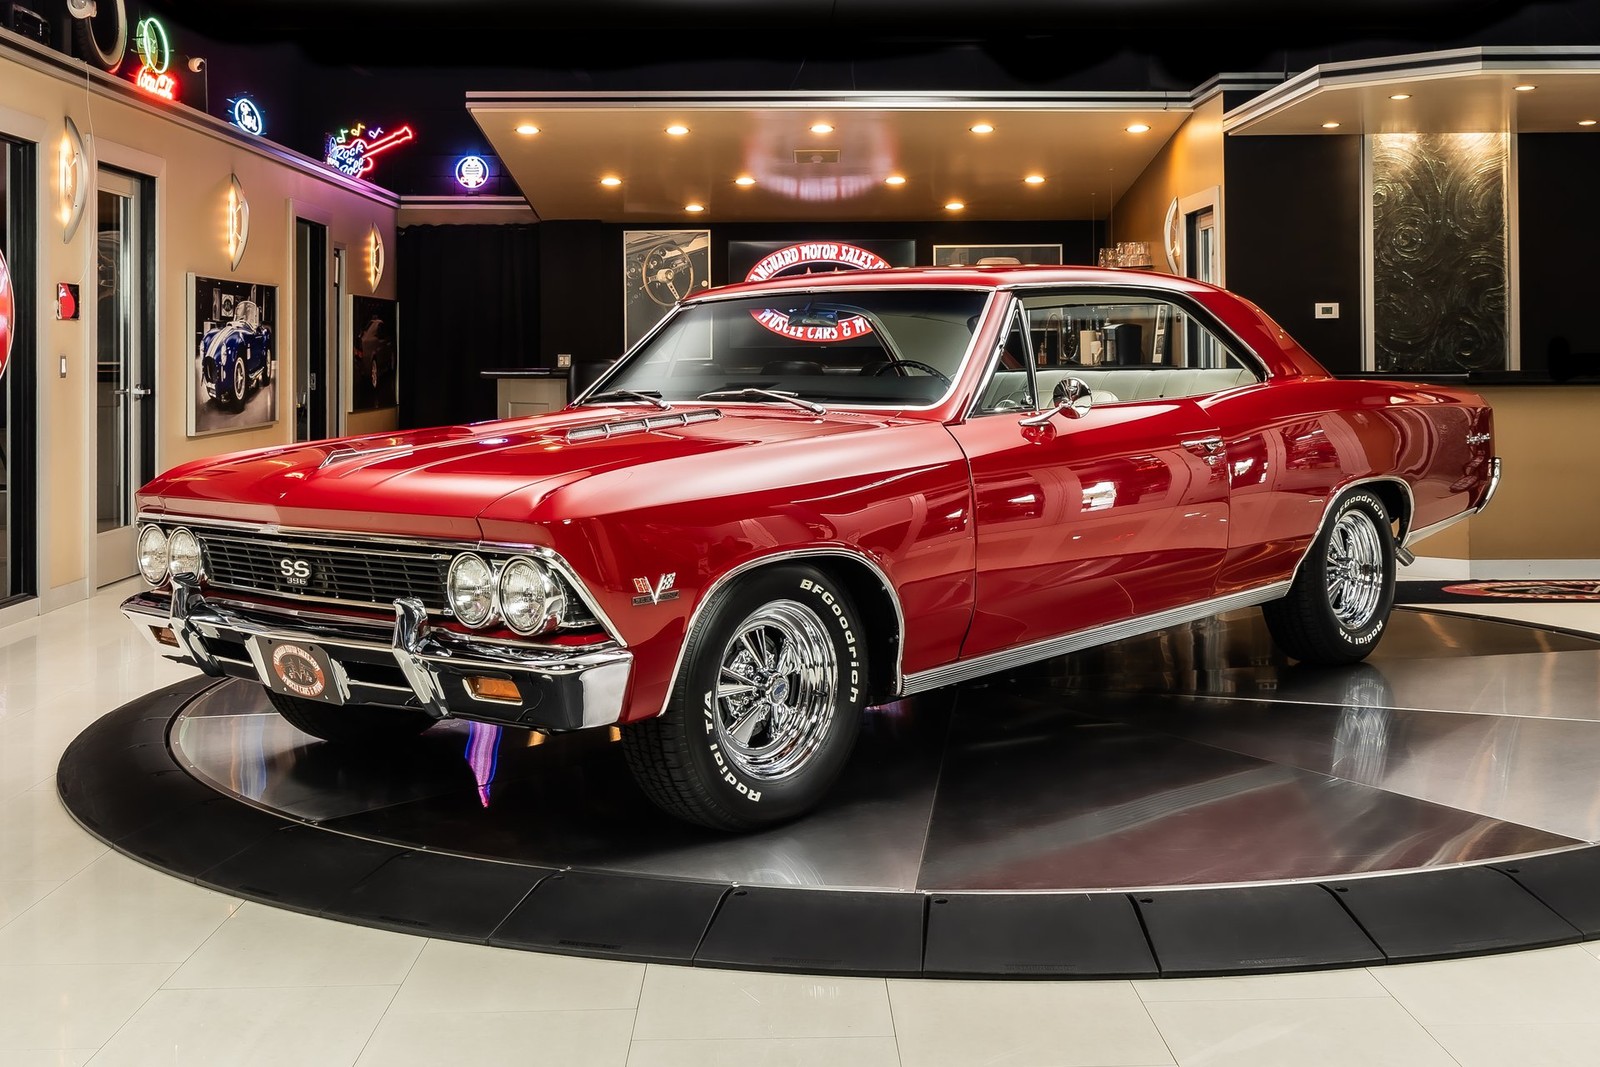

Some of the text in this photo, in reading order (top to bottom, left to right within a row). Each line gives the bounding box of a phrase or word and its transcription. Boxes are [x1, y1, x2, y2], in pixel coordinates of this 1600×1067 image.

[748, 248, 799, 282] ANGUARD
[800, 244, 839, 260] MOTOR
[758, 308, 804, 338] MUSCLE
[807, 325, 838, 340] CARS
[841, 322, 852, 337] &
[1334, 494, 1384, 524] BFGoodrich
[280, 559, 310, 577] SS
[286, 577, 306, 585] 396
[799, 578, 860, 703] BFGoodrich
[1355, 619, 1383, 646] Radial
[709, 743, 762, 803] Radial
